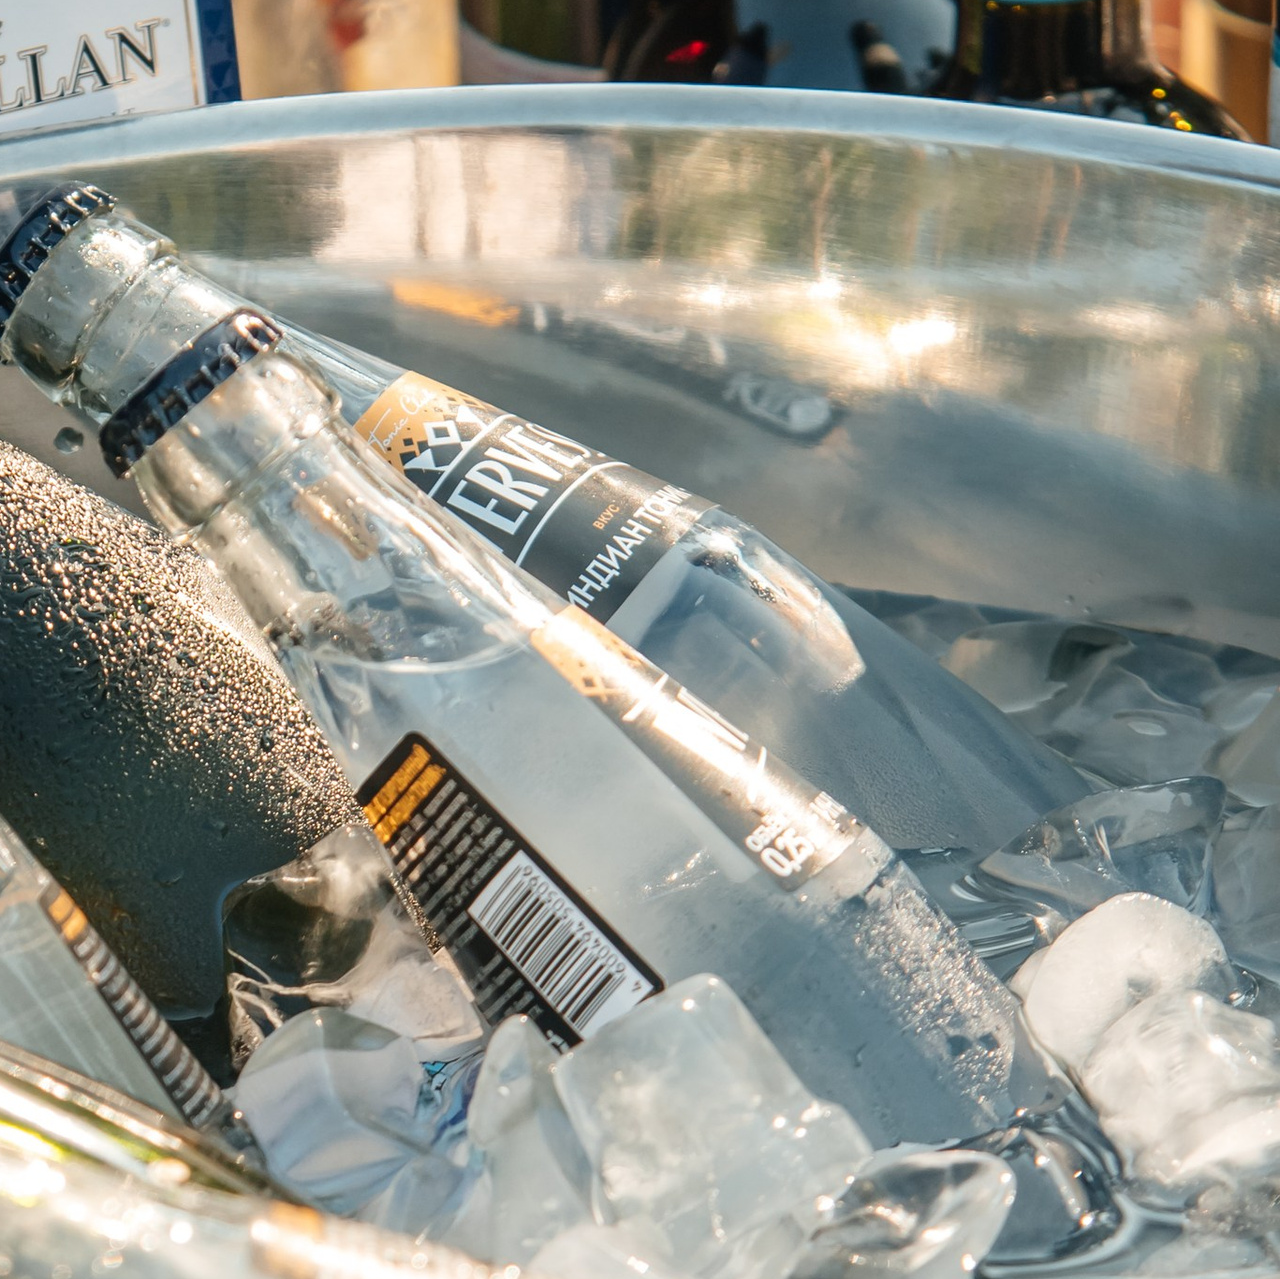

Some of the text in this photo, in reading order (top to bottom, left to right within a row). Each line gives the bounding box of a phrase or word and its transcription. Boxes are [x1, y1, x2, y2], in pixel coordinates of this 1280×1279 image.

[367, 408, 409, 454] Tonic
[592, 503, 621, 530] ВКУС
[567, 518, 654, 609] ИНДИАН
[761, 827, 815, 877] 0,25
